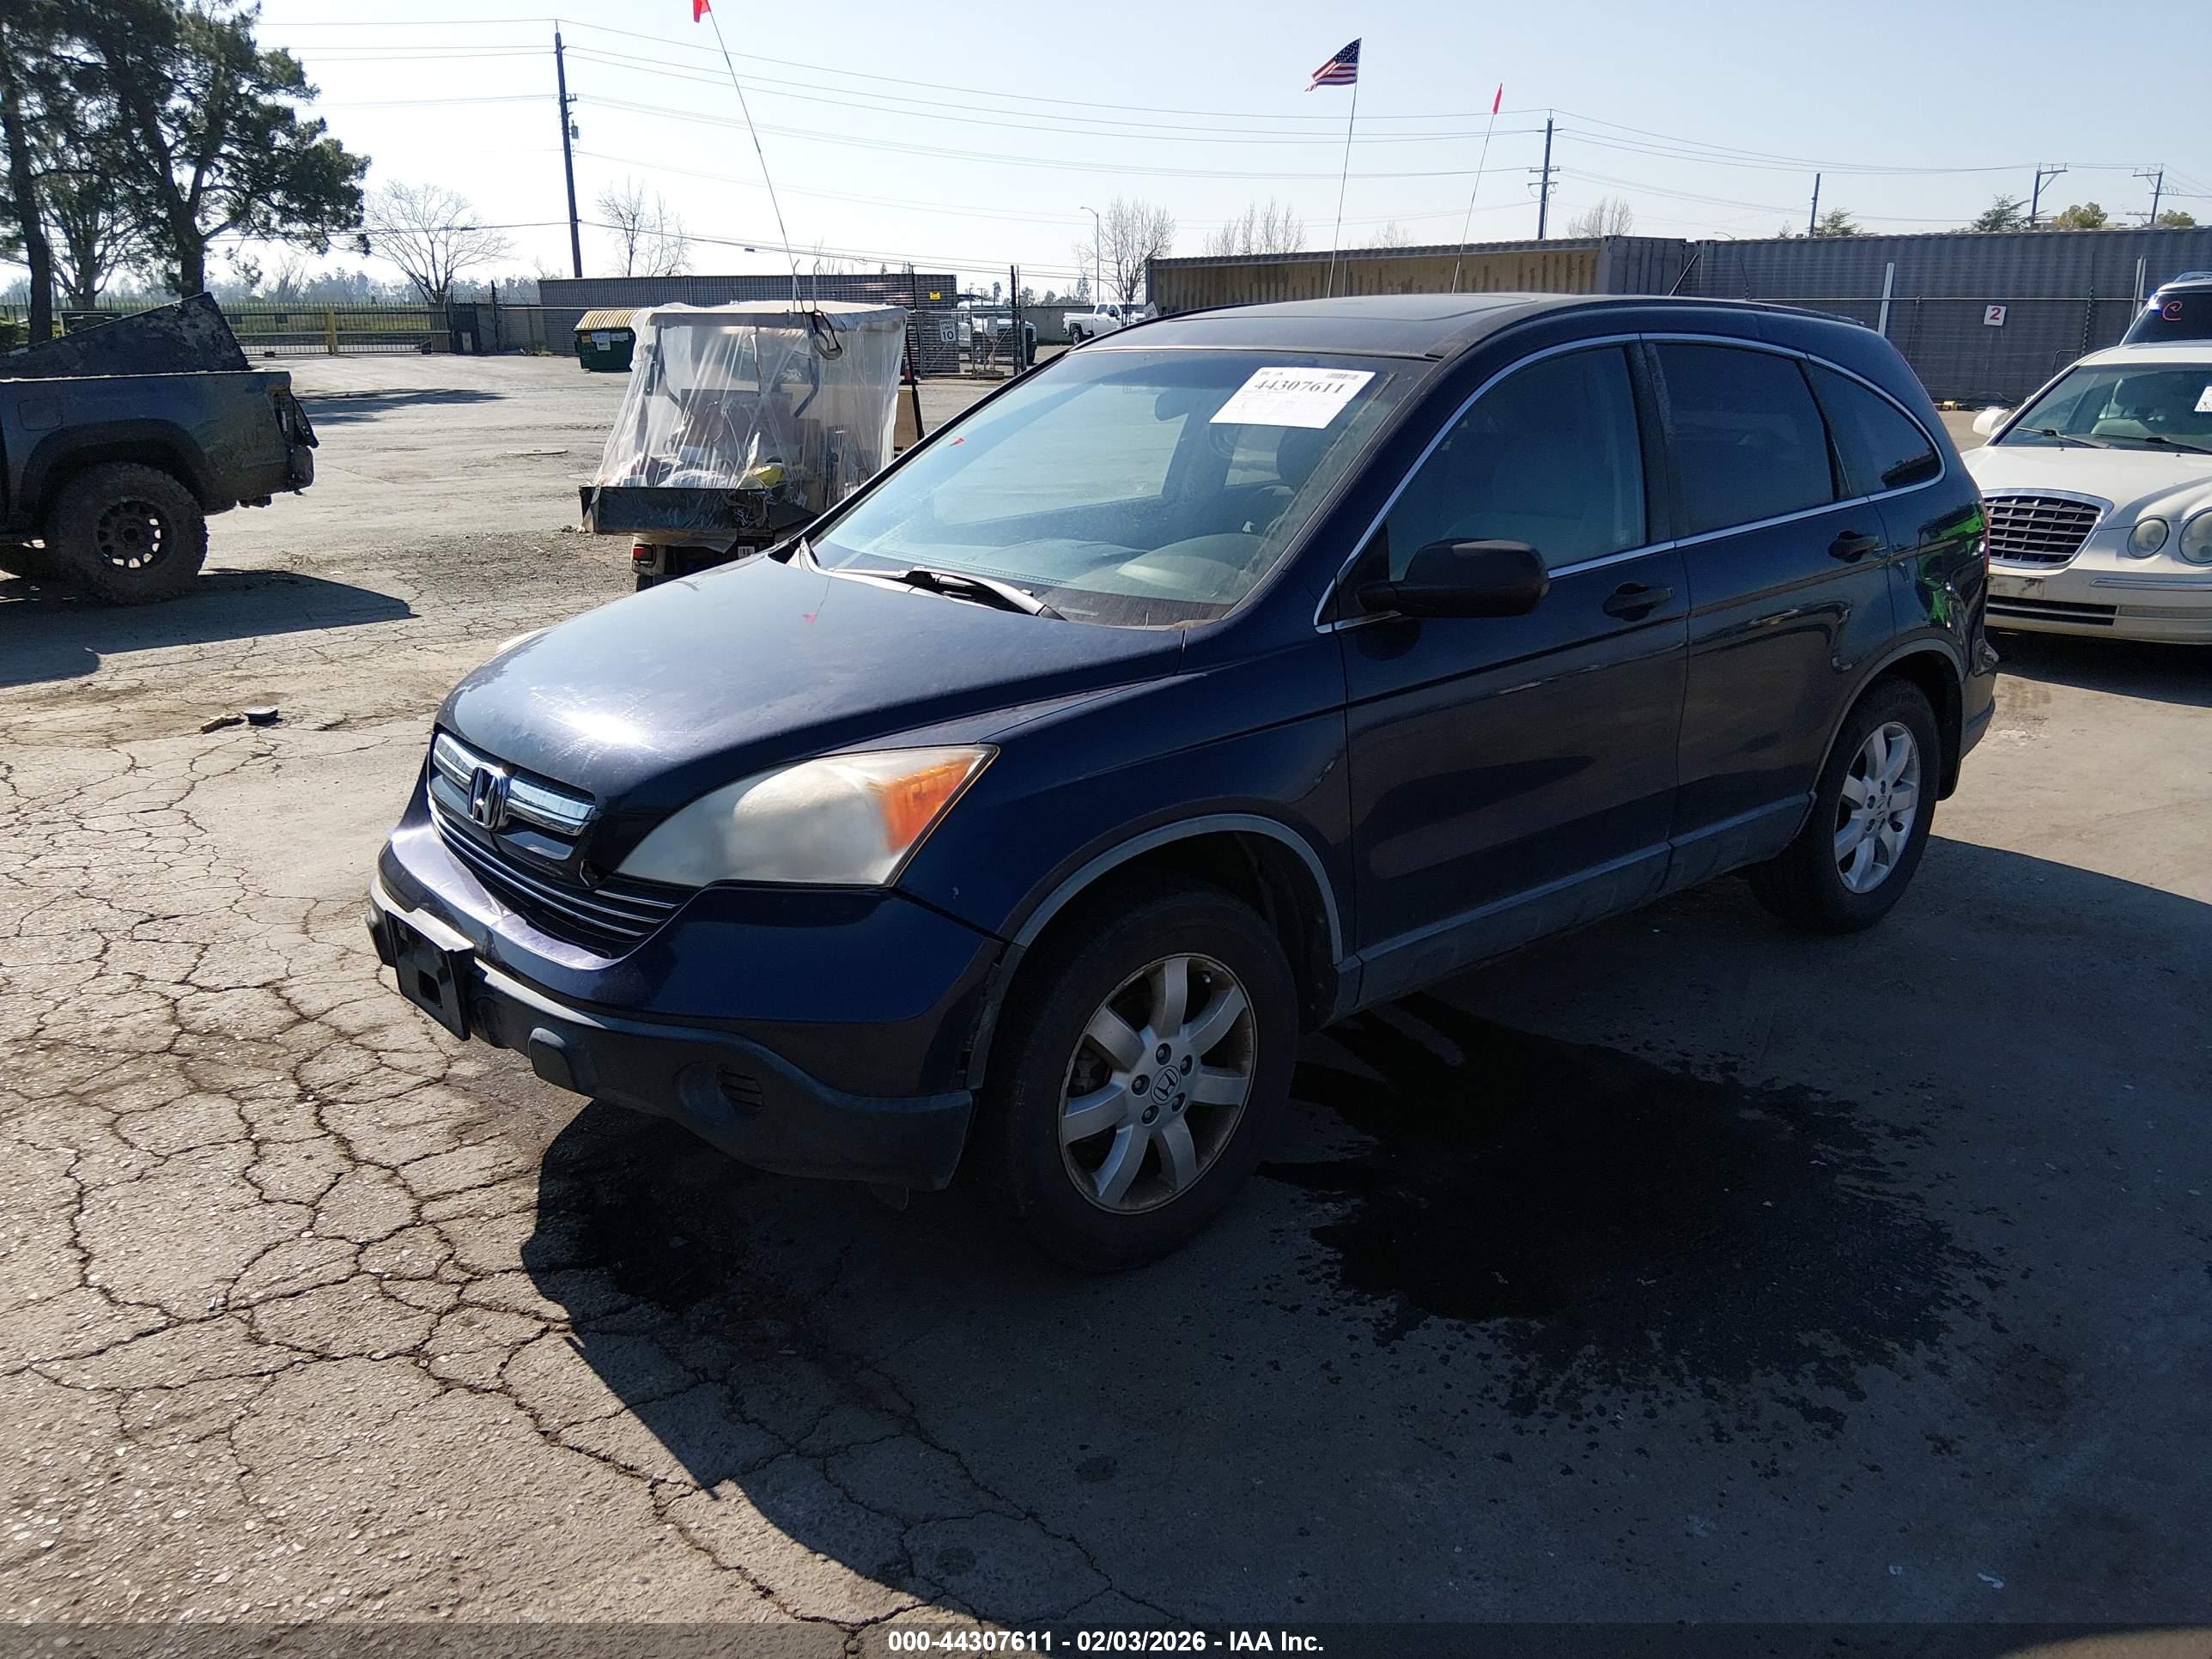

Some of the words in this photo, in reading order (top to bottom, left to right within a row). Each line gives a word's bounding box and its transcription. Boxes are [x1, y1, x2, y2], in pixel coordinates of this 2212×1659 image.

[1989, 307, 2001, 320] 2
[943, 331, 954, 341] 10
[1255, 380, 1346, 393] 44307611
